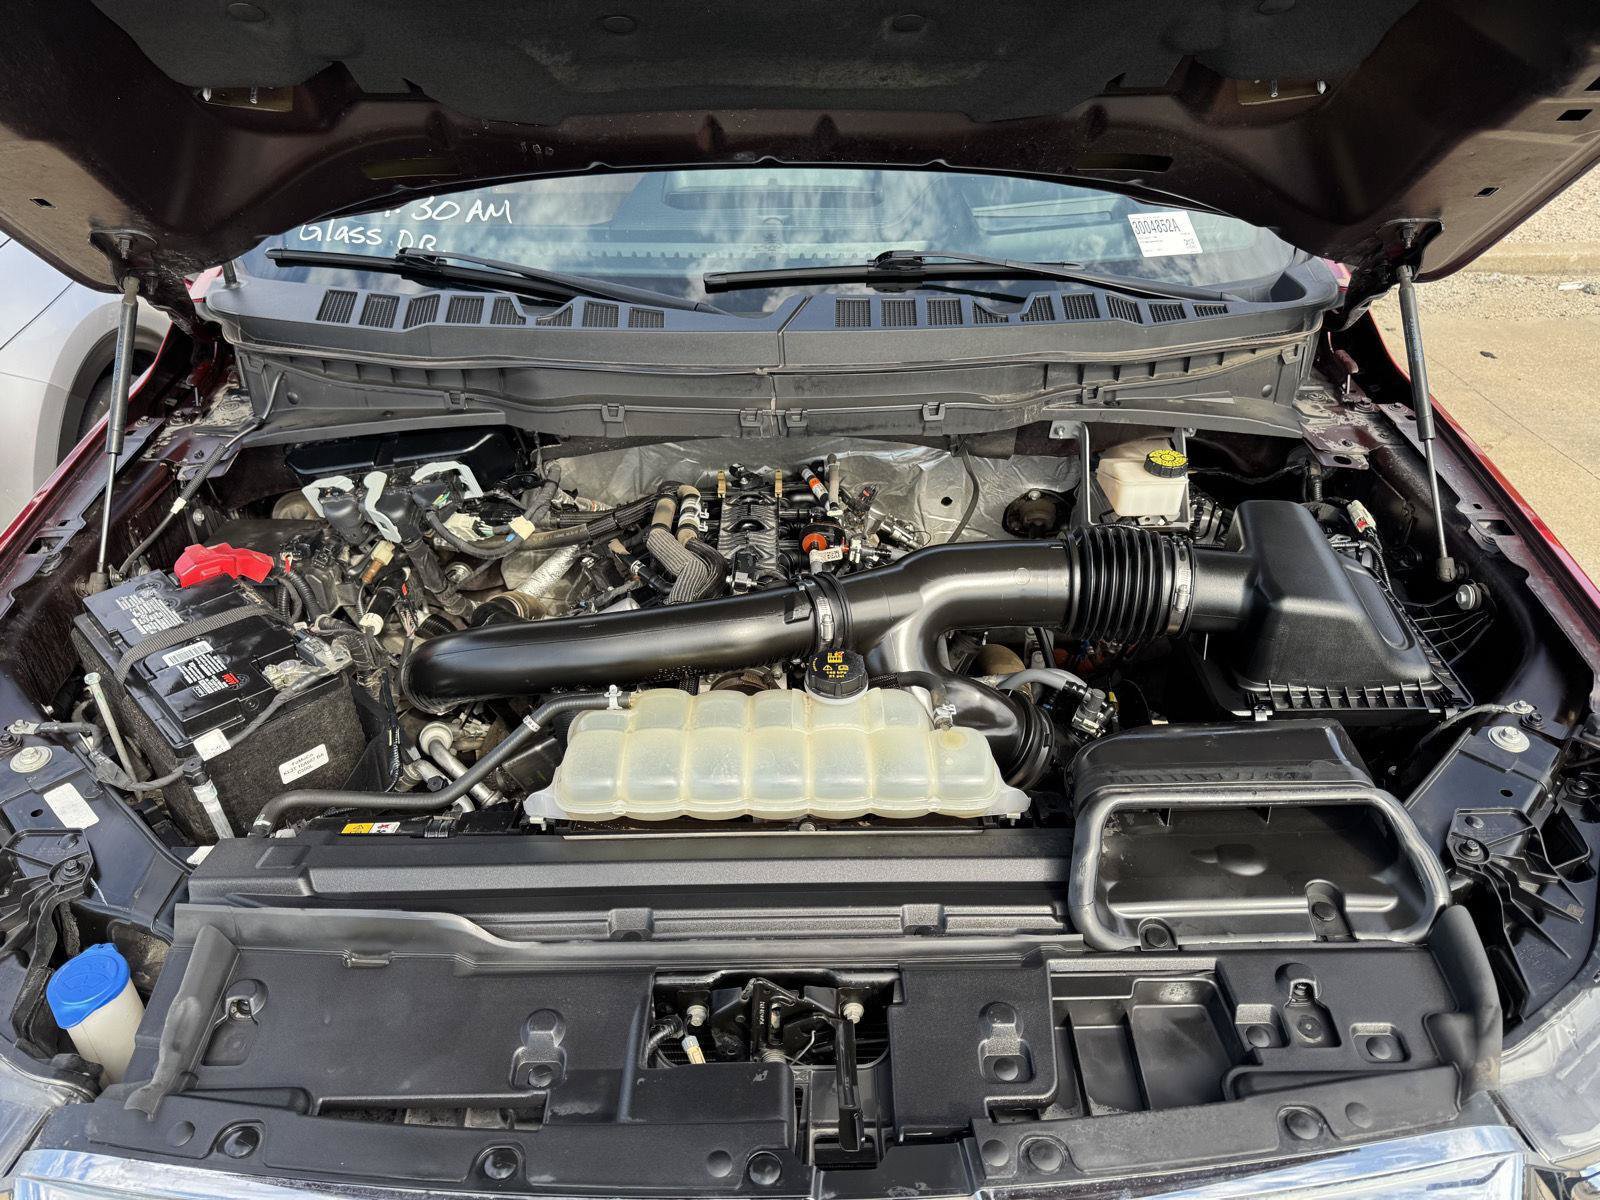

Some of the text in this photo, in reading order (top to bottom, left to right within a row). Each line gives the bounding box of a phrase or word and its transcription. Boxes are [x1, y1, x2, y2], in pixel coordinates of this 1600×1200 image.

[465, 199, 512, 224] AM
[299, 218, 383, 246] Glass
[1132, 218, 1181, 234] 3004852A
